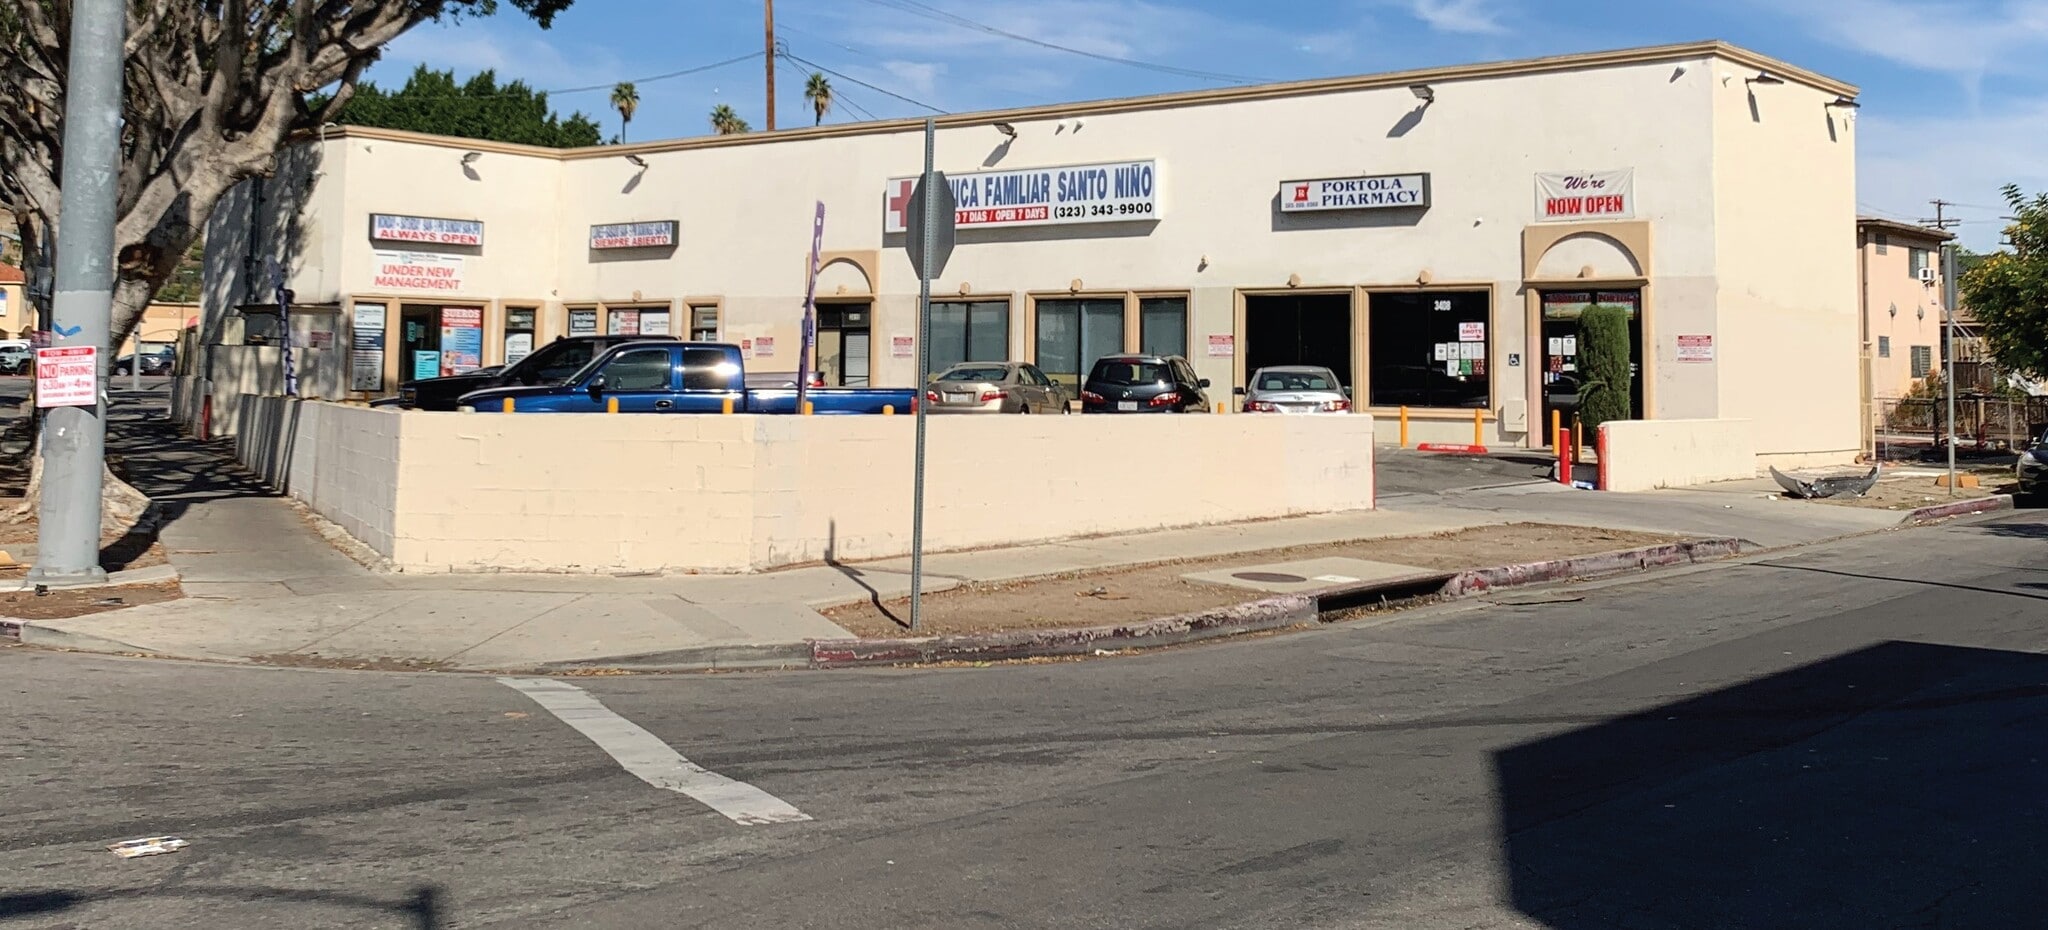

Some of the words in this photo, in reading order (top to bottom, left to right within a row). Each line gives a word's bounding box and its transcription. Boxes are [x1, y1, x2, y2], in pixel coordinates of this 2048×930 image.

[985, 173, 1050, 206] FAMILIAR
[1057, 168, 1107, 202] SANTO
[1115, 164, 1152, 199] NIÑO
[1321, 178, 1403, 193] PORTOLA
[1563, 174, 1605, 190] We're
[1322, 190, 1419, 206] PHARMACY
[1546, 197, 1582, 215] NOW
[1586, 195, 1623, 214] OPEN
[962, 212, 968, 223] 7
[969, 210, 987, 222] DIAS
[995, 210, 1015, 222] OPEN
[1018, 209, 1024, 219] 7
[1025, 207, 1045, 219] DAYS
[1054, 205, 1086, 219] (323)
[1091, 202, 1152, 216] 343-9900
[380, 229, 436, 241] ALWAYS
[441, 233, 478, 243] OPEN
[595, 237, 629, 247] SIEMPRE
[632, 235, 668, 246] ABIERTO
[382, 264, 424, 276] UNDER
[427, 266, 455, 278] NEW
[375, 276, 461, 289] MANAGEMENT
[41, 364, 58, 378] NO
[60, 364, 93, 376] PARKING
